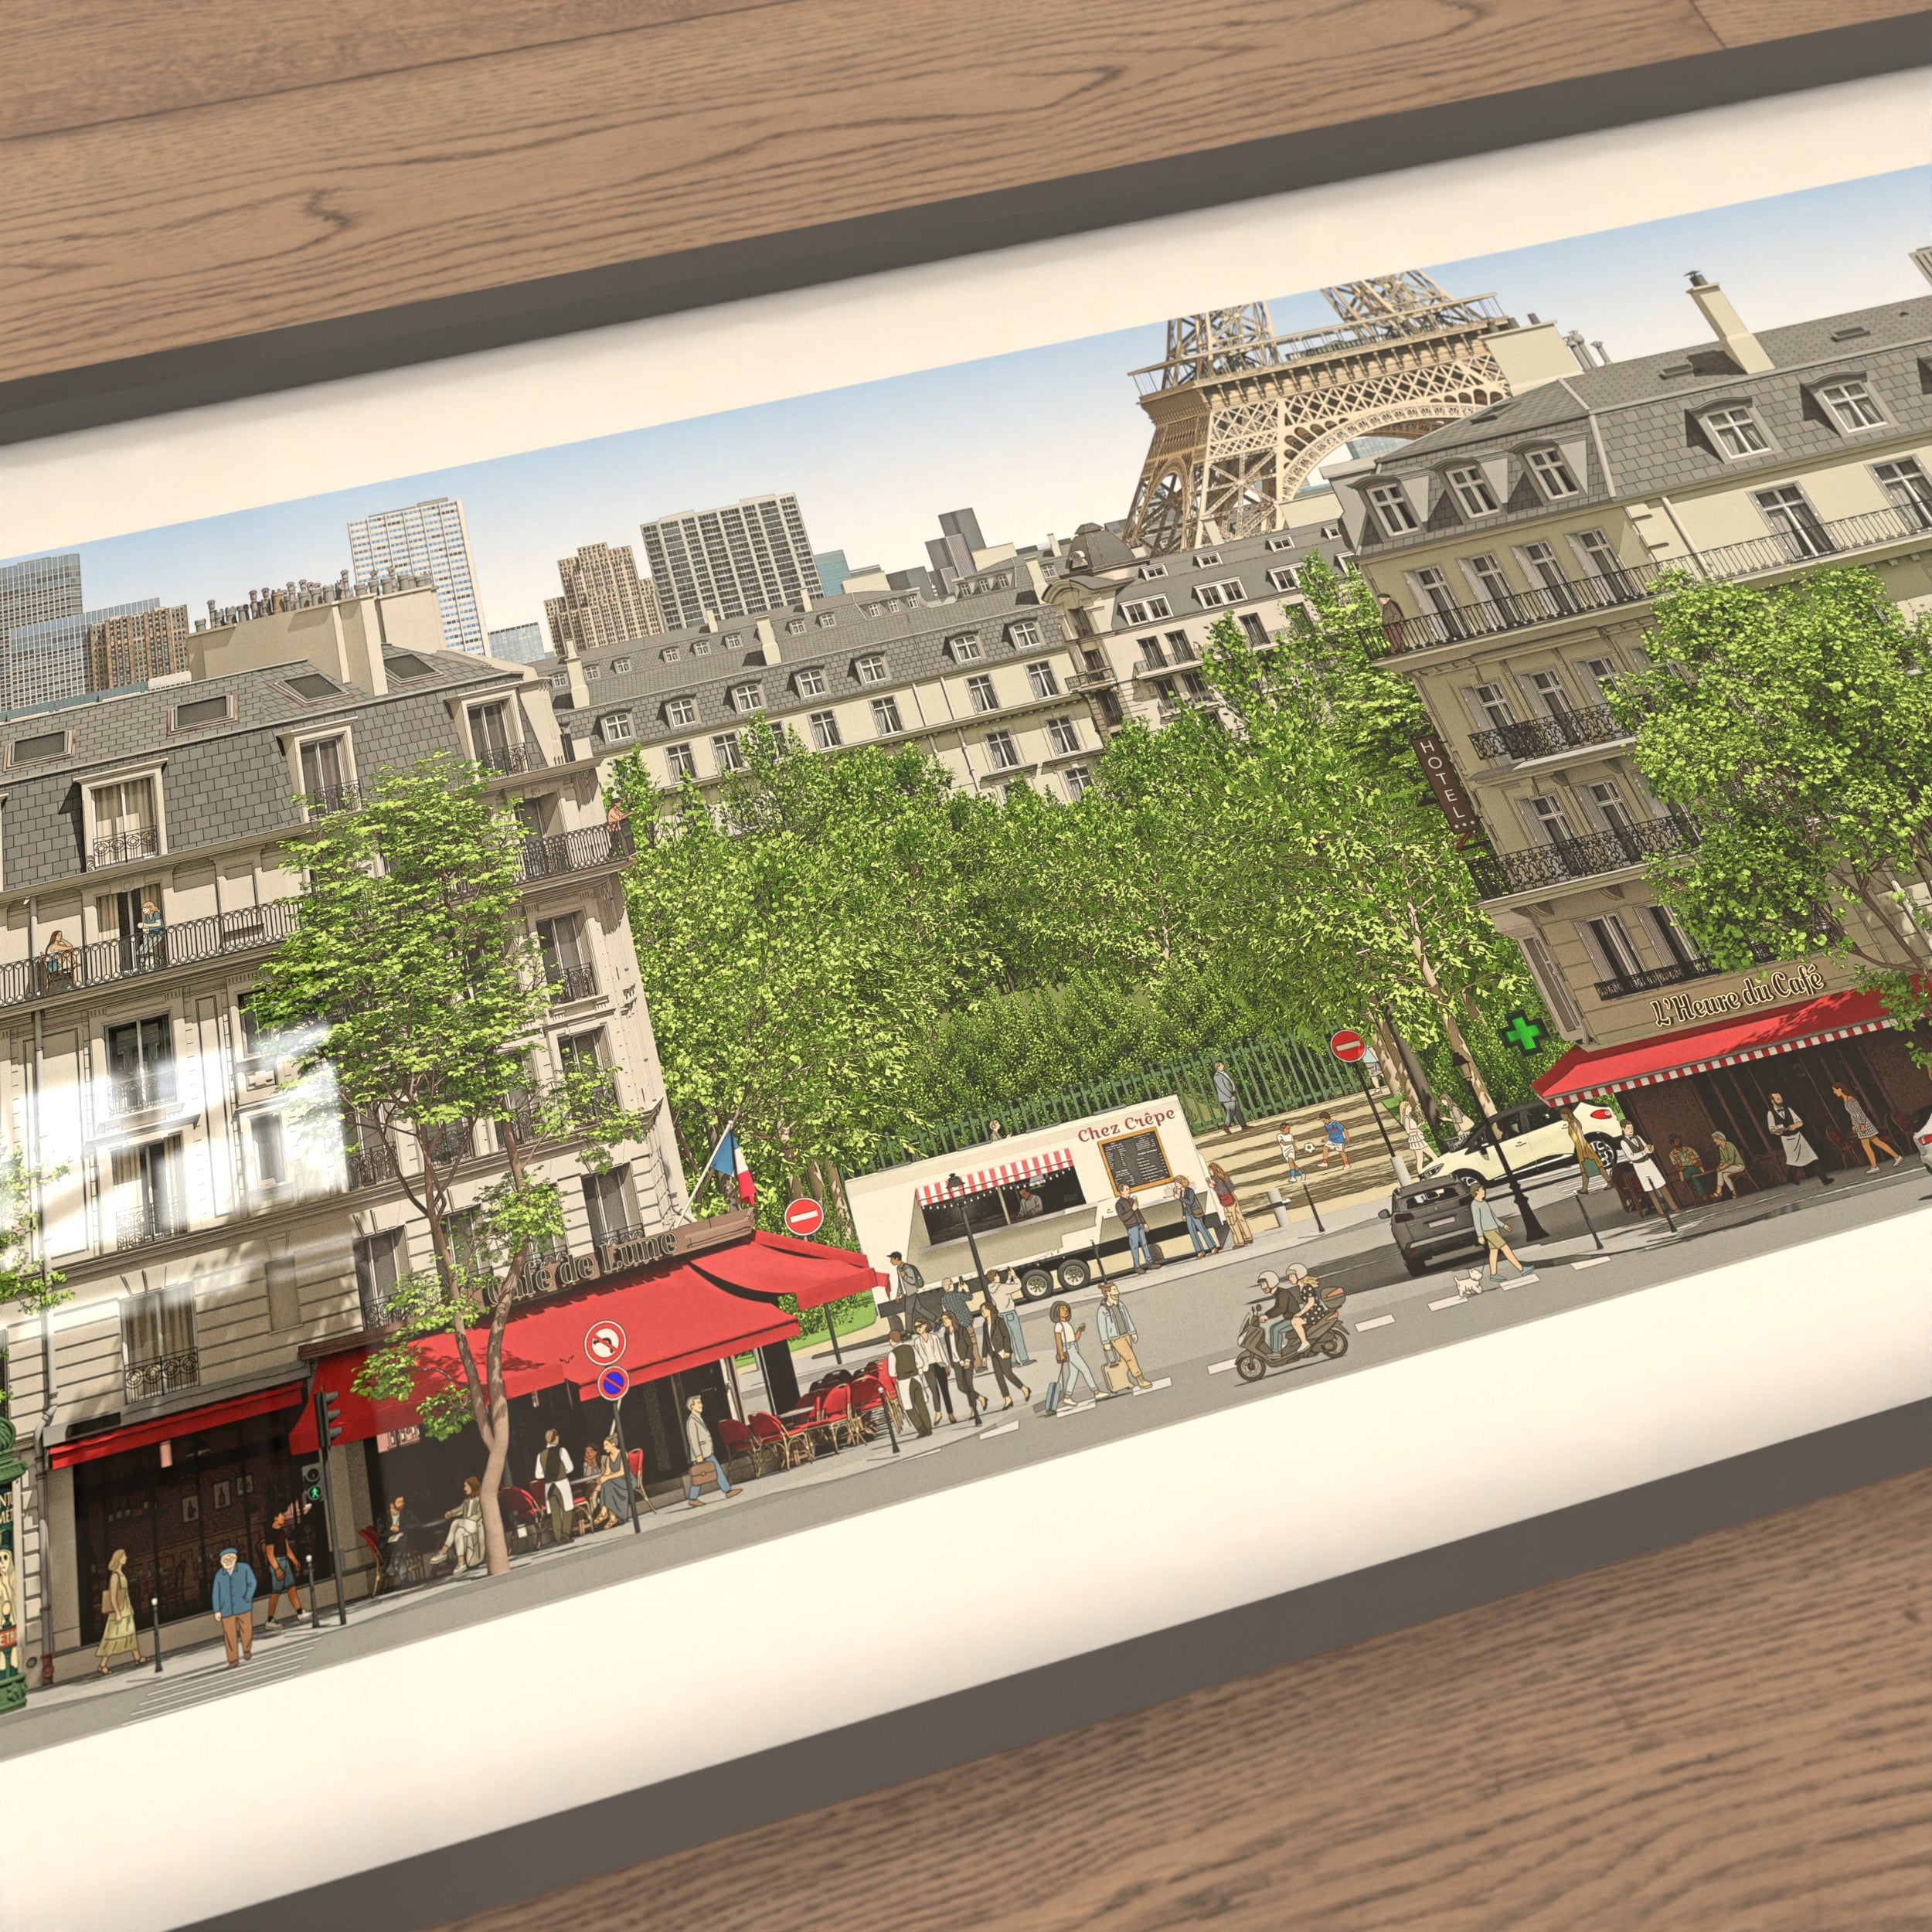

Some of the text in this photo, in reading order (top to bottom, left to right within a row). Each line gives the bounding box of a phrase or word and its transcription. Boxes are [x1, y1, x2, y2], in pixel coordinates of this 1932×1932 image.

[1420, 740, 1465, 818] HOTEL
[1650, 964, 1825, 1027] L'Heure du Café
[1078, 1124, 1121, 1142] Chez
[1124, 1110, 1175, 1130] Crêpe
[560, 1254, 595, 1284] de
[599, 1232, 678, 1274] Lune
